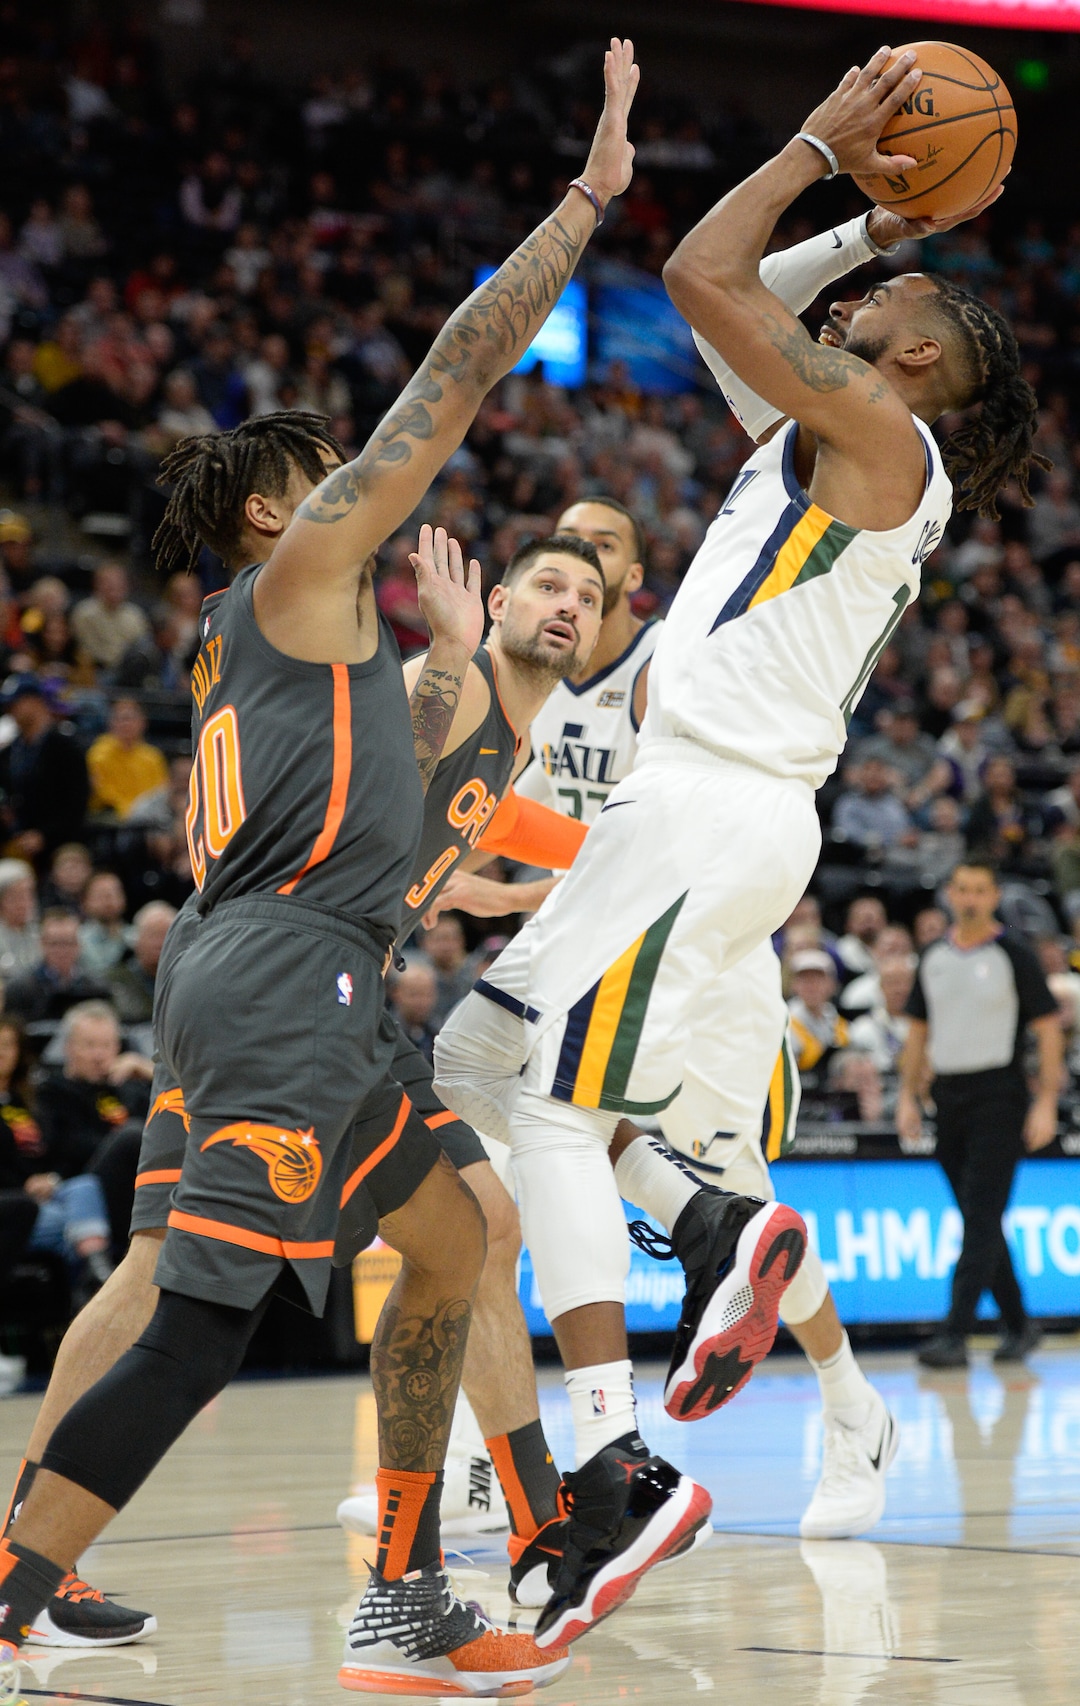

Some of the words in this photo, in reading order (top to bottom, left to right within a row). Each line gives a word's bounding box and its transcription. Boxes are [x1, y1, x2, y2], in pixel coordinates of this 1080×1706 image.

[185, 704, 247, 895] 20
[404, 845, 460, 910] 9
[468, 1456, 491, 1512] NIKE
